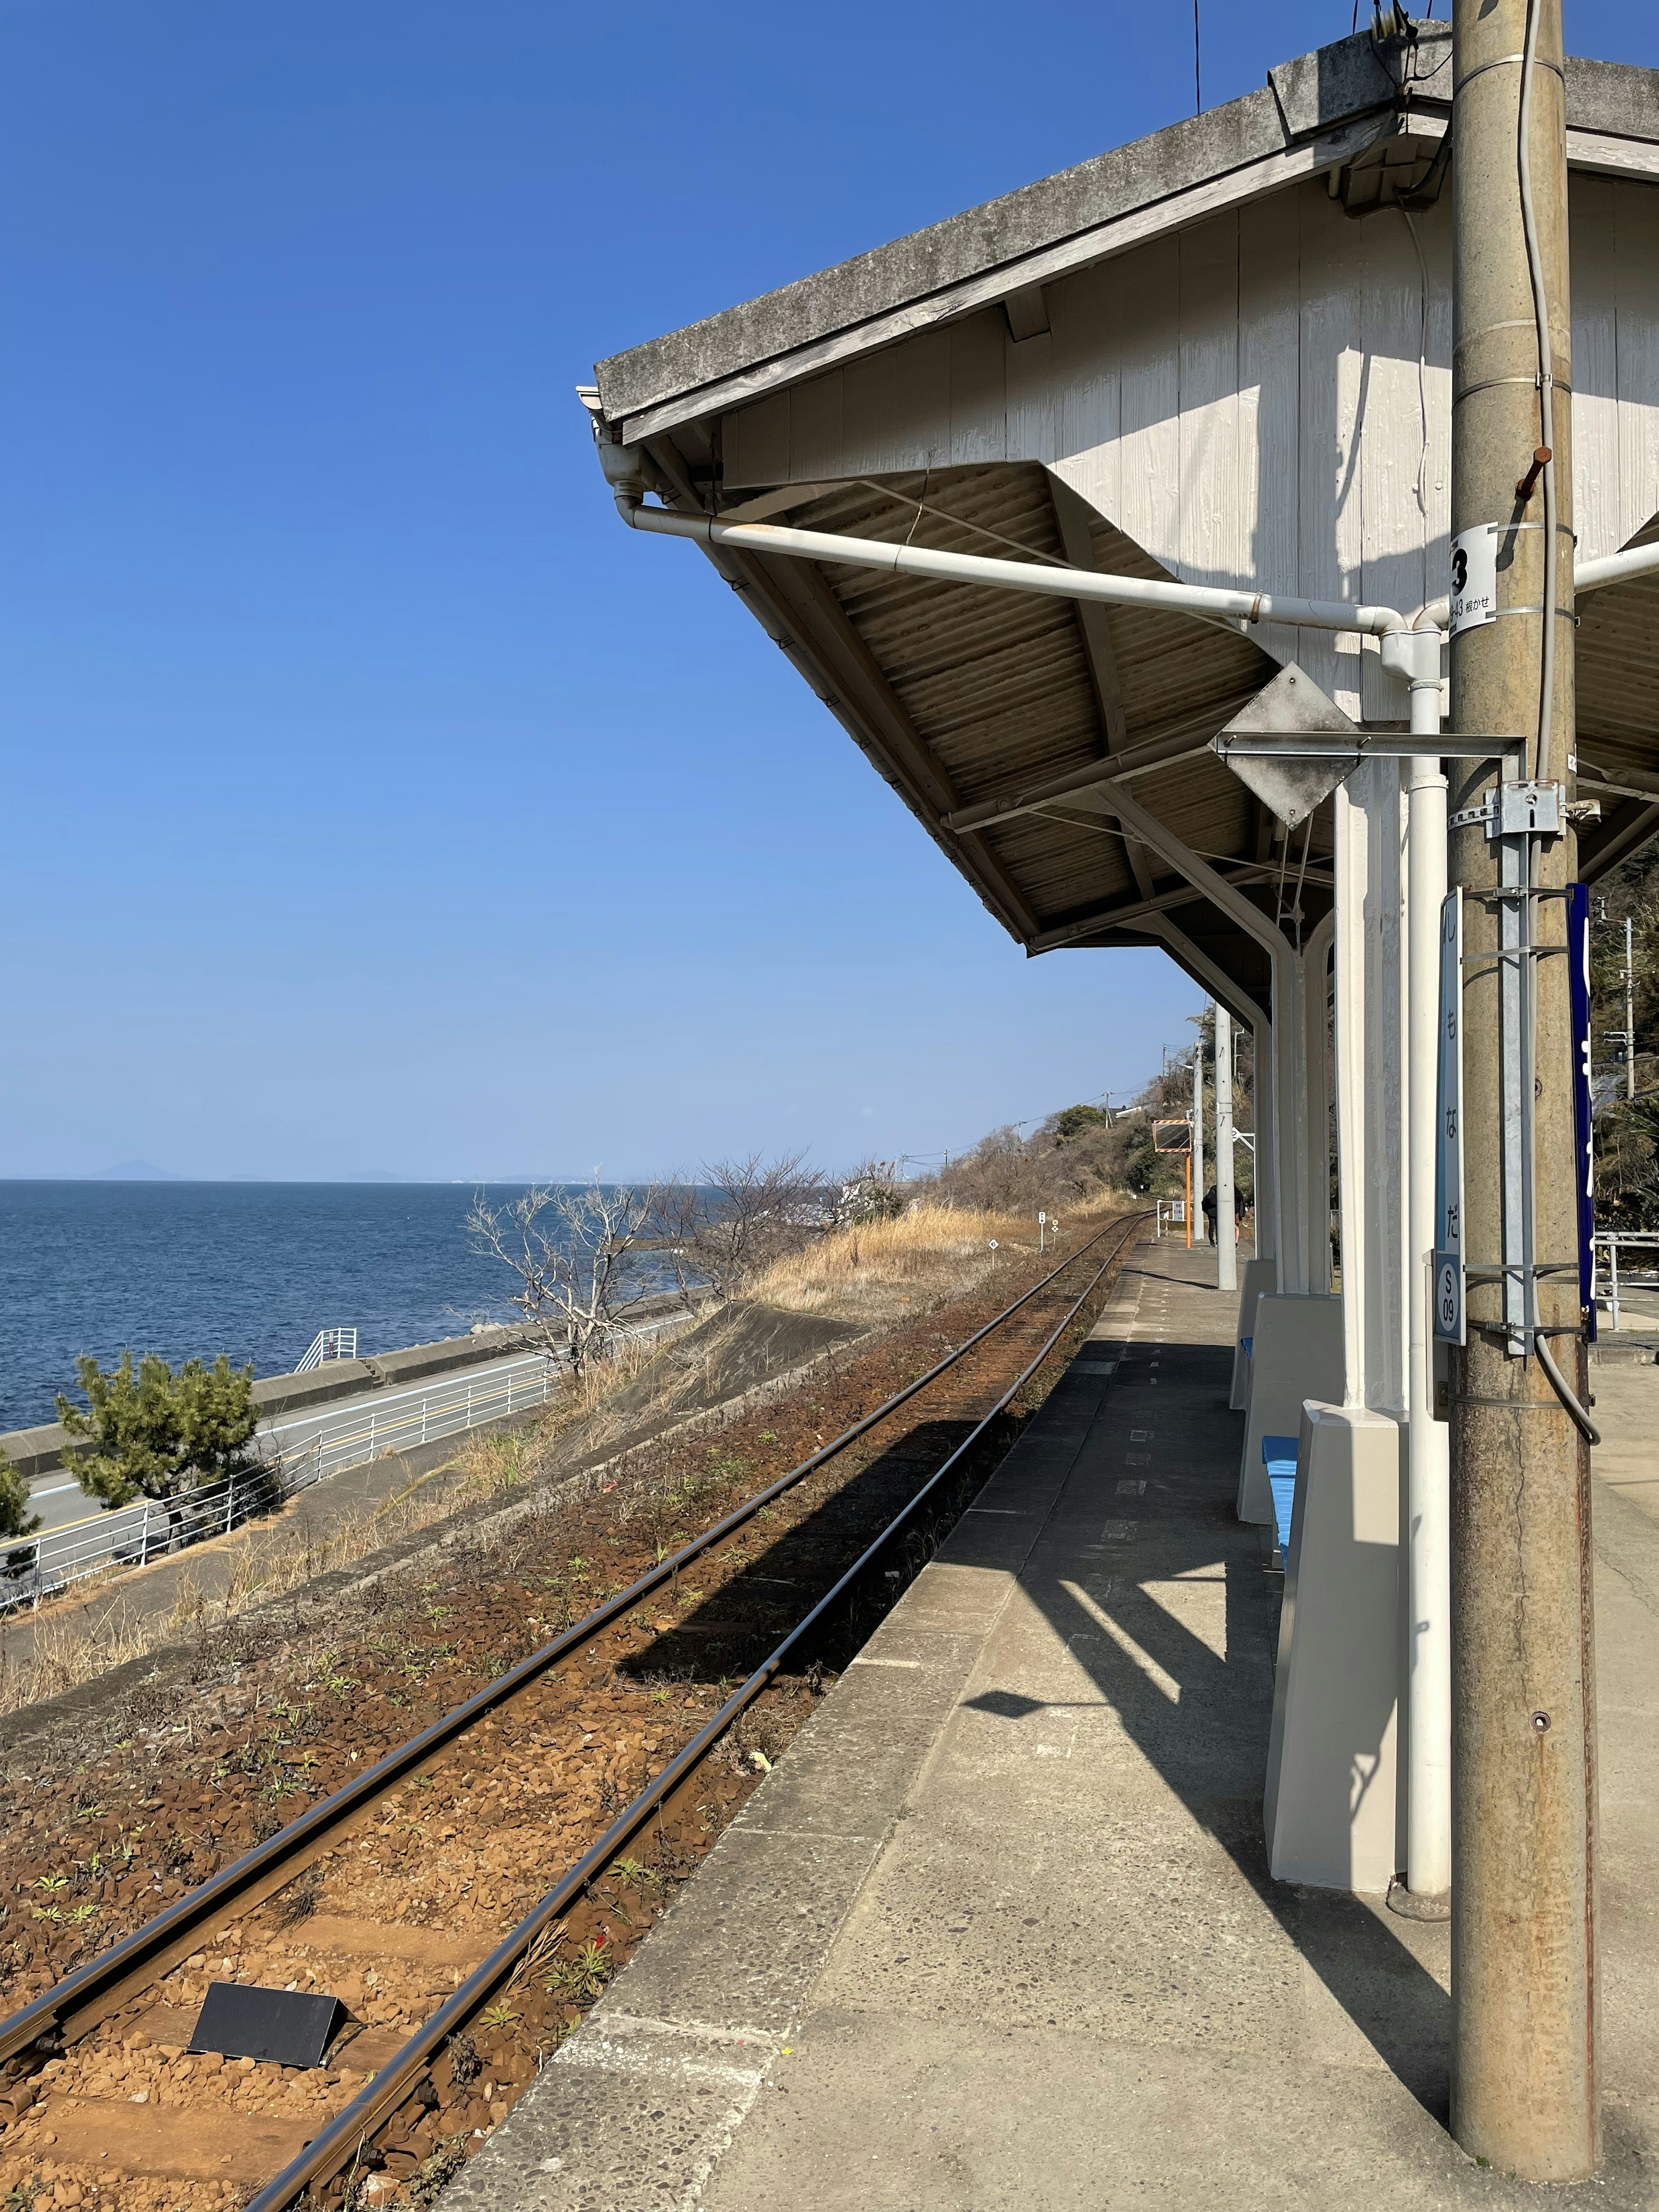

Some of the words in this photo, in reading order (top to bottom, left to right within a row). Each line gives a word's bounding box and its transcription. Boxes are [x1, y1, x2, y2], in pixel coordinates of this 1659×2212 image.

[1452, 548, 1468, 596] 3
[1466, 596, 1489, 613] 根かせ
[1446, 912, 1458, 1238] しもなだ
[1446, 1270, 1452, 1294] S
[1443, 1298, 1453, 1322] 09
